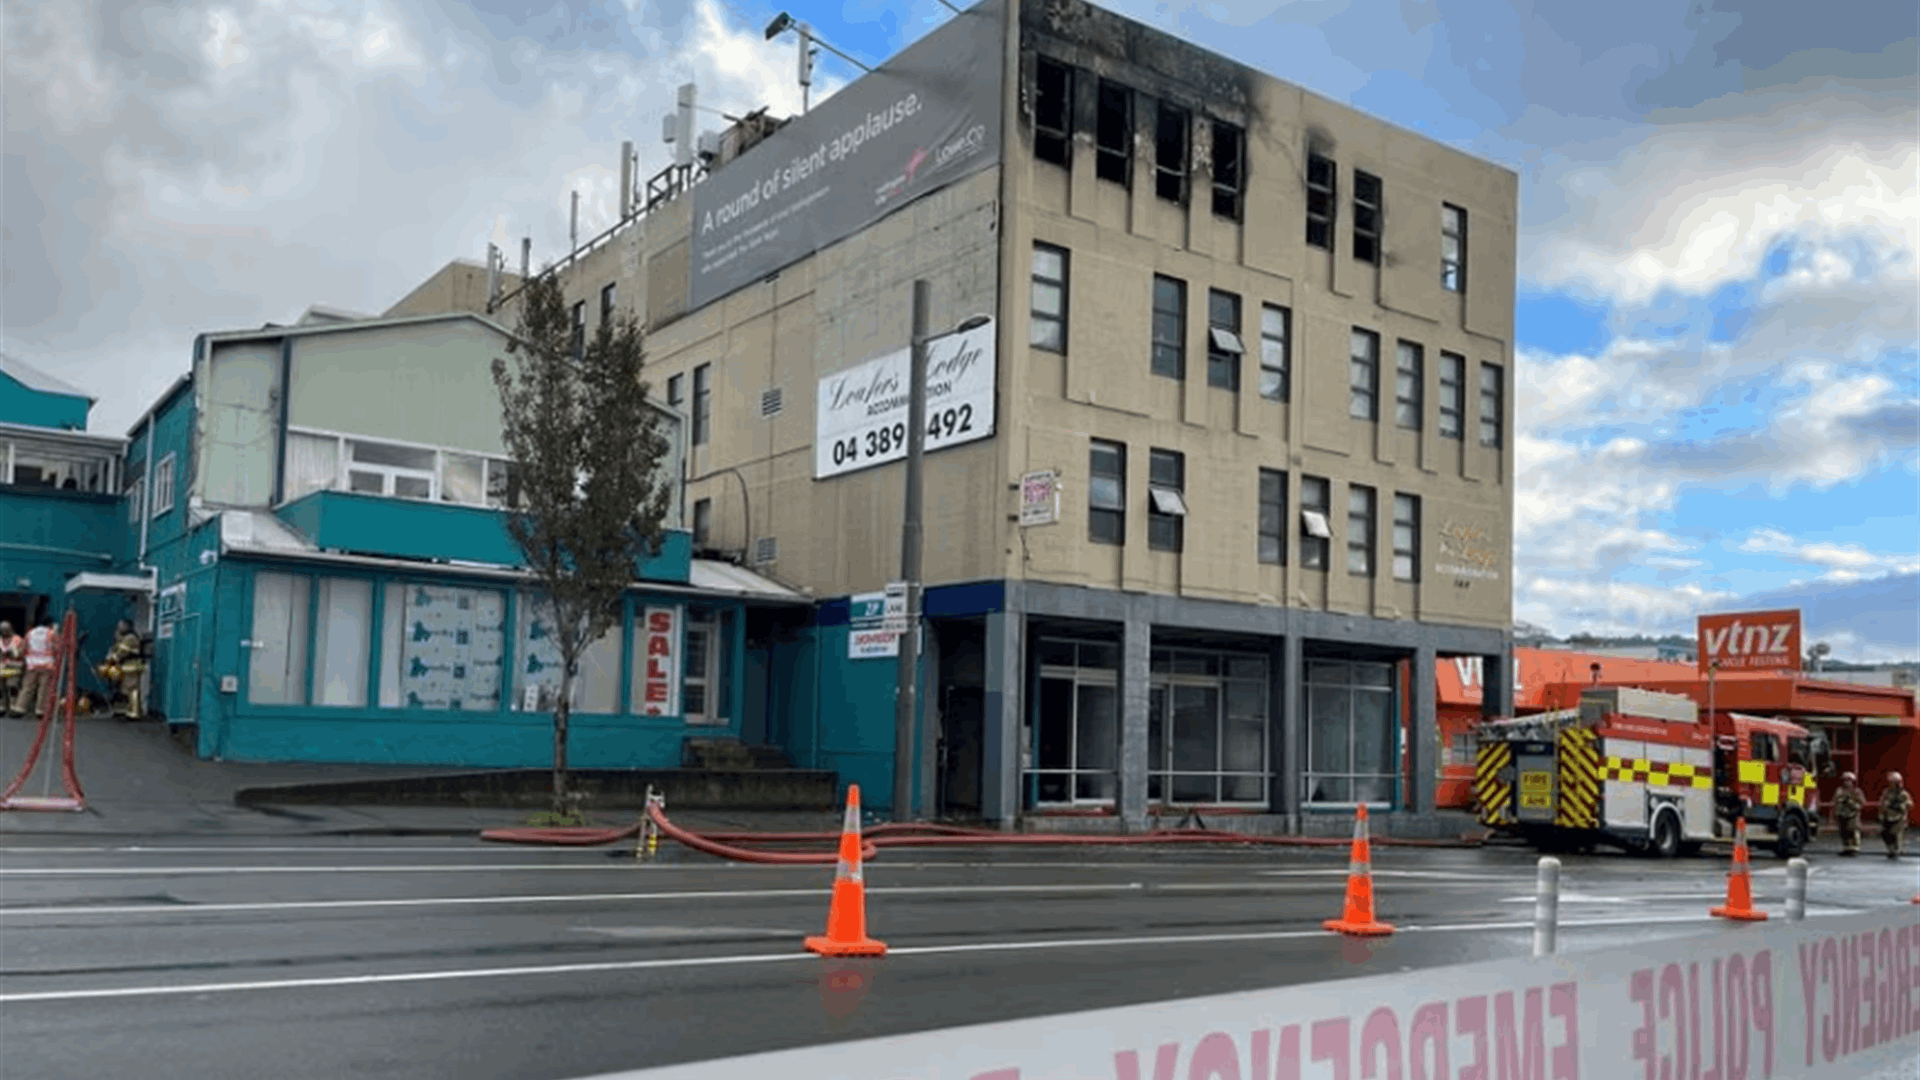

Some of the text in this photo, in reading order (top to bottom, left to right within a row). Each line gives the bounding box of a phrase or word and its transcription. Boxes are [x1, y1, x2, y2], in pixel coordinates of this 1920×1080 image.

[702, 210, 714, 236] A
[715, 179, 760, 229] round
[762, 168, 780, 201] of
[783, 143, 826, 191] silent
[829, 93, 923, 162] applause.
[833, 403, 973, 467] 04 389 492
[645, 611, 672, 702] SALE
[1705, 618, 1793, 656] vtnz
